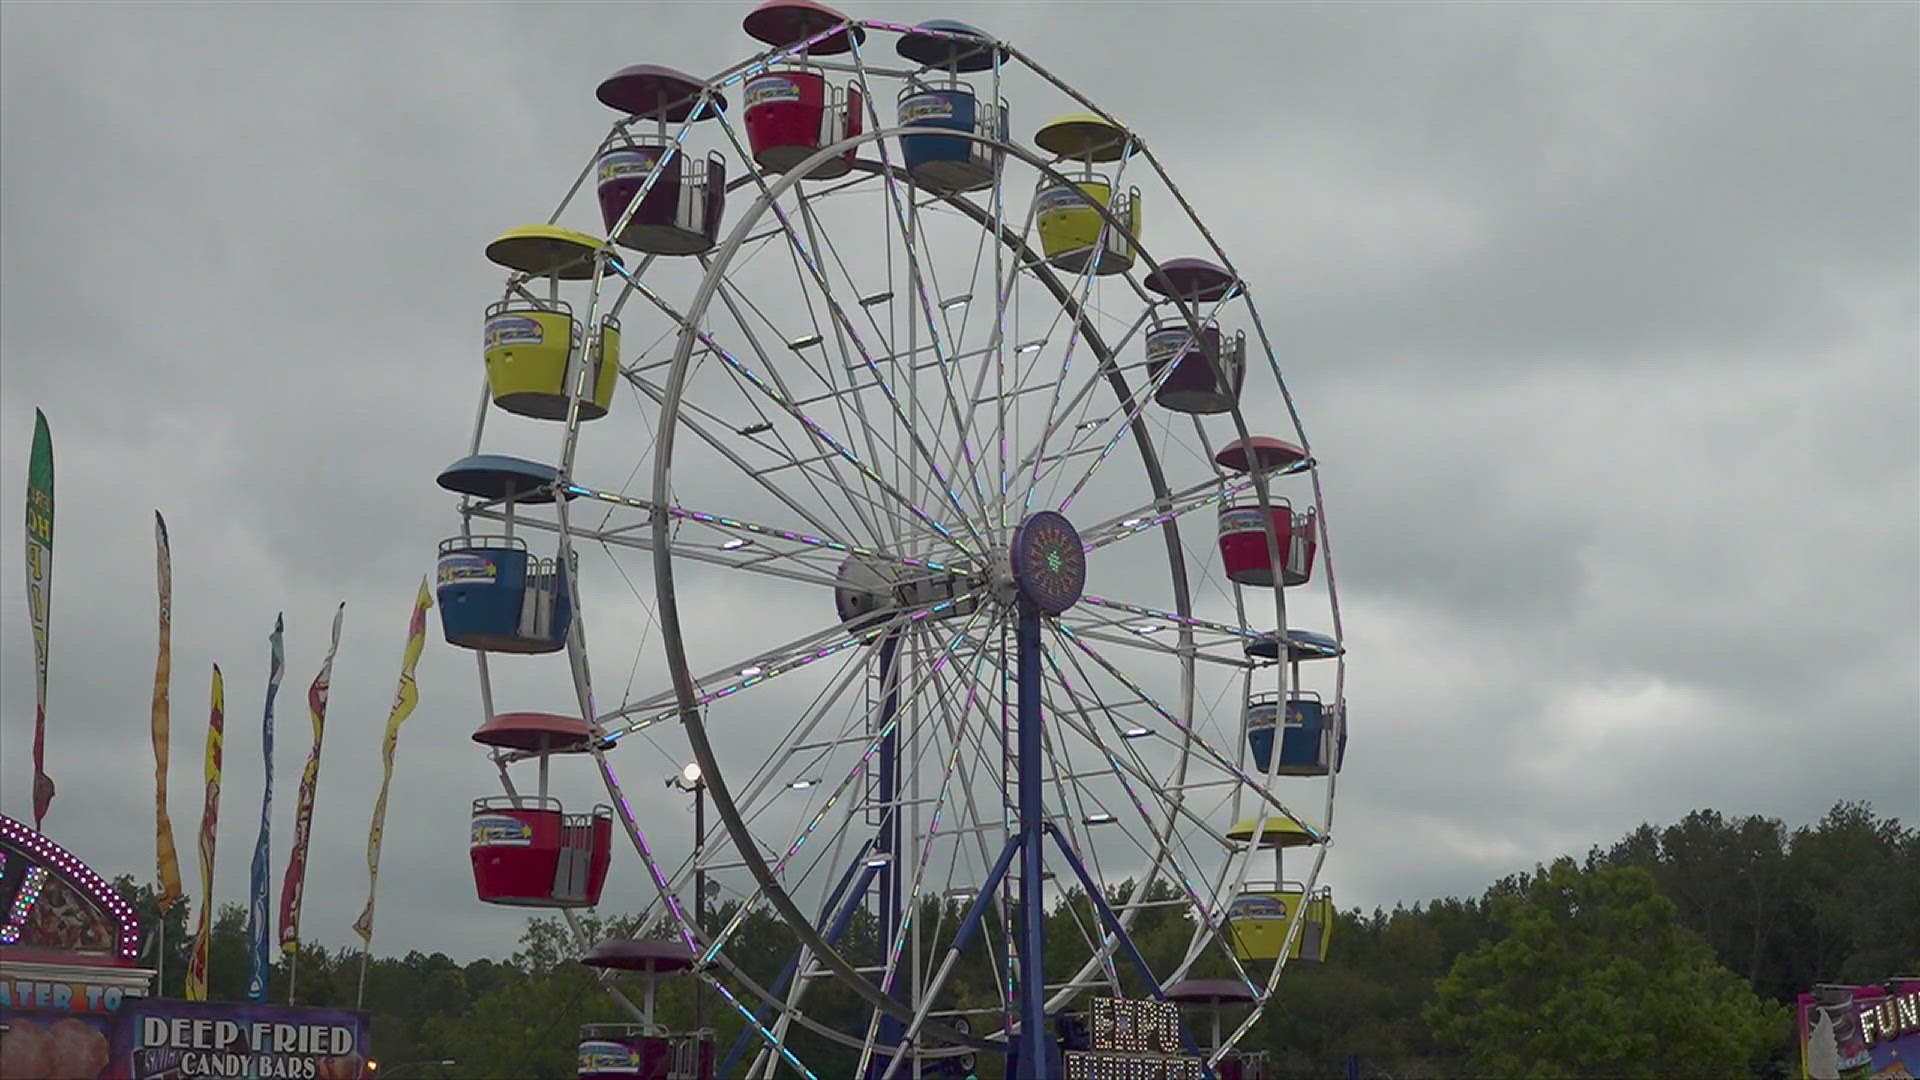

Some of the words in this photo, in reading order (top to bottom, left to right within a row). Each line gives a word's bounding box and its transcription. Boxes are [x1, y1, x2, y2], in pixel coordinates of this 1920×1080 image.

[143, 1016, 240, 1050] DEEP
[251, 1022, 354, 1056] FRIED
[1860, 990, 1920, 1043] FUN
[181, 1051, 252, 1077] CANDY
[259, 1055, 316, 1080] BARS
